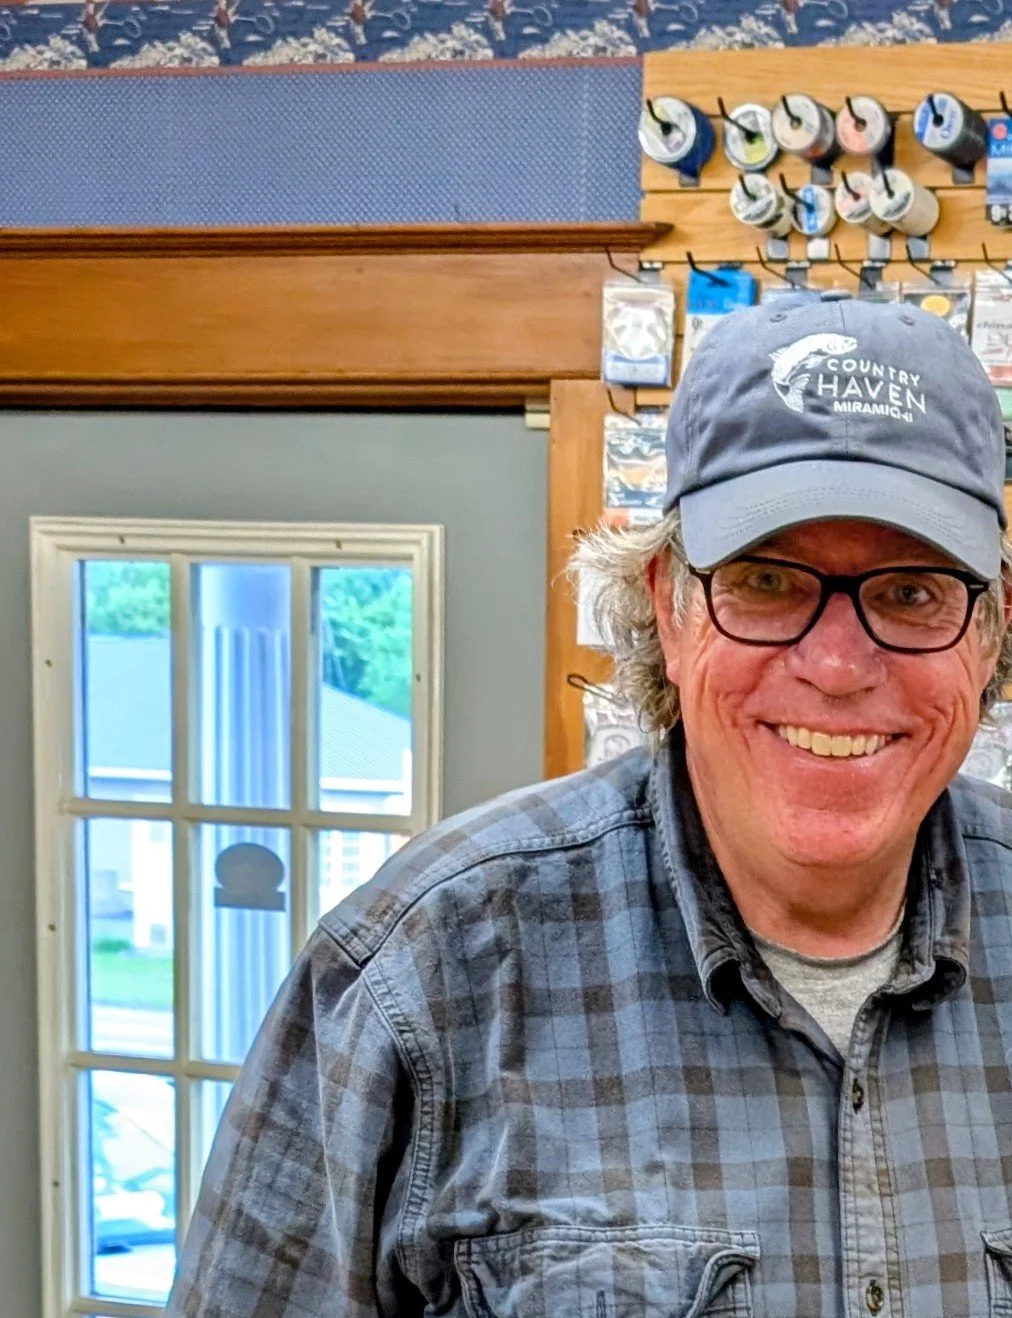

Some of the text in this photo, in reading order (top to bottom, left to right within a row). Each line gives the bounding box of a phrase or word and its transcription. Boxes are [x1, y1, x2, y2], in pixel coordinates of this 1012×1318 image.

[827, 358, 921, 387] COUNTRY
[816, 373, 927, 415] HAVEN
[833, 400, 914, 423] MIRAMICHI
